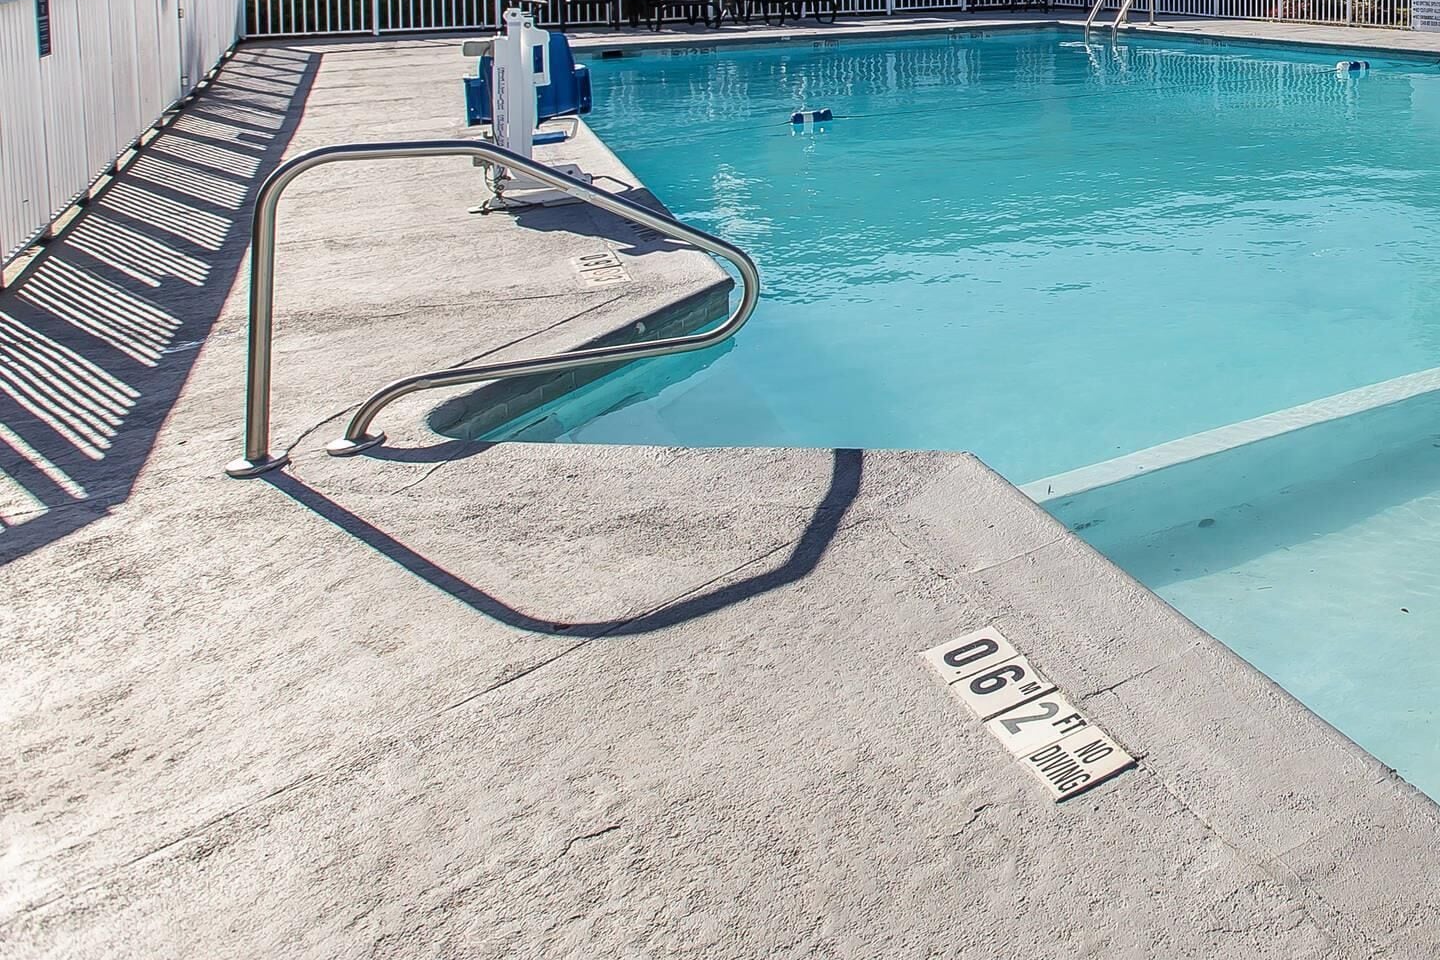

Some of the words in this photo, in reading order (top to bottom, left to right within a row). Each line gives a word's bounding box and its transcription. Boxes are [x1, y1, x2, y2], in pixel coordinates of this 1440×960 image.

[1018, 681, 1042, 696] M
[1000, 702, 1060, 735] 2
[1052, 713, 1086, 734] FT
[1074, 739, 1114, 764] NO
[1029, 744, 1092, 794] DIVING
